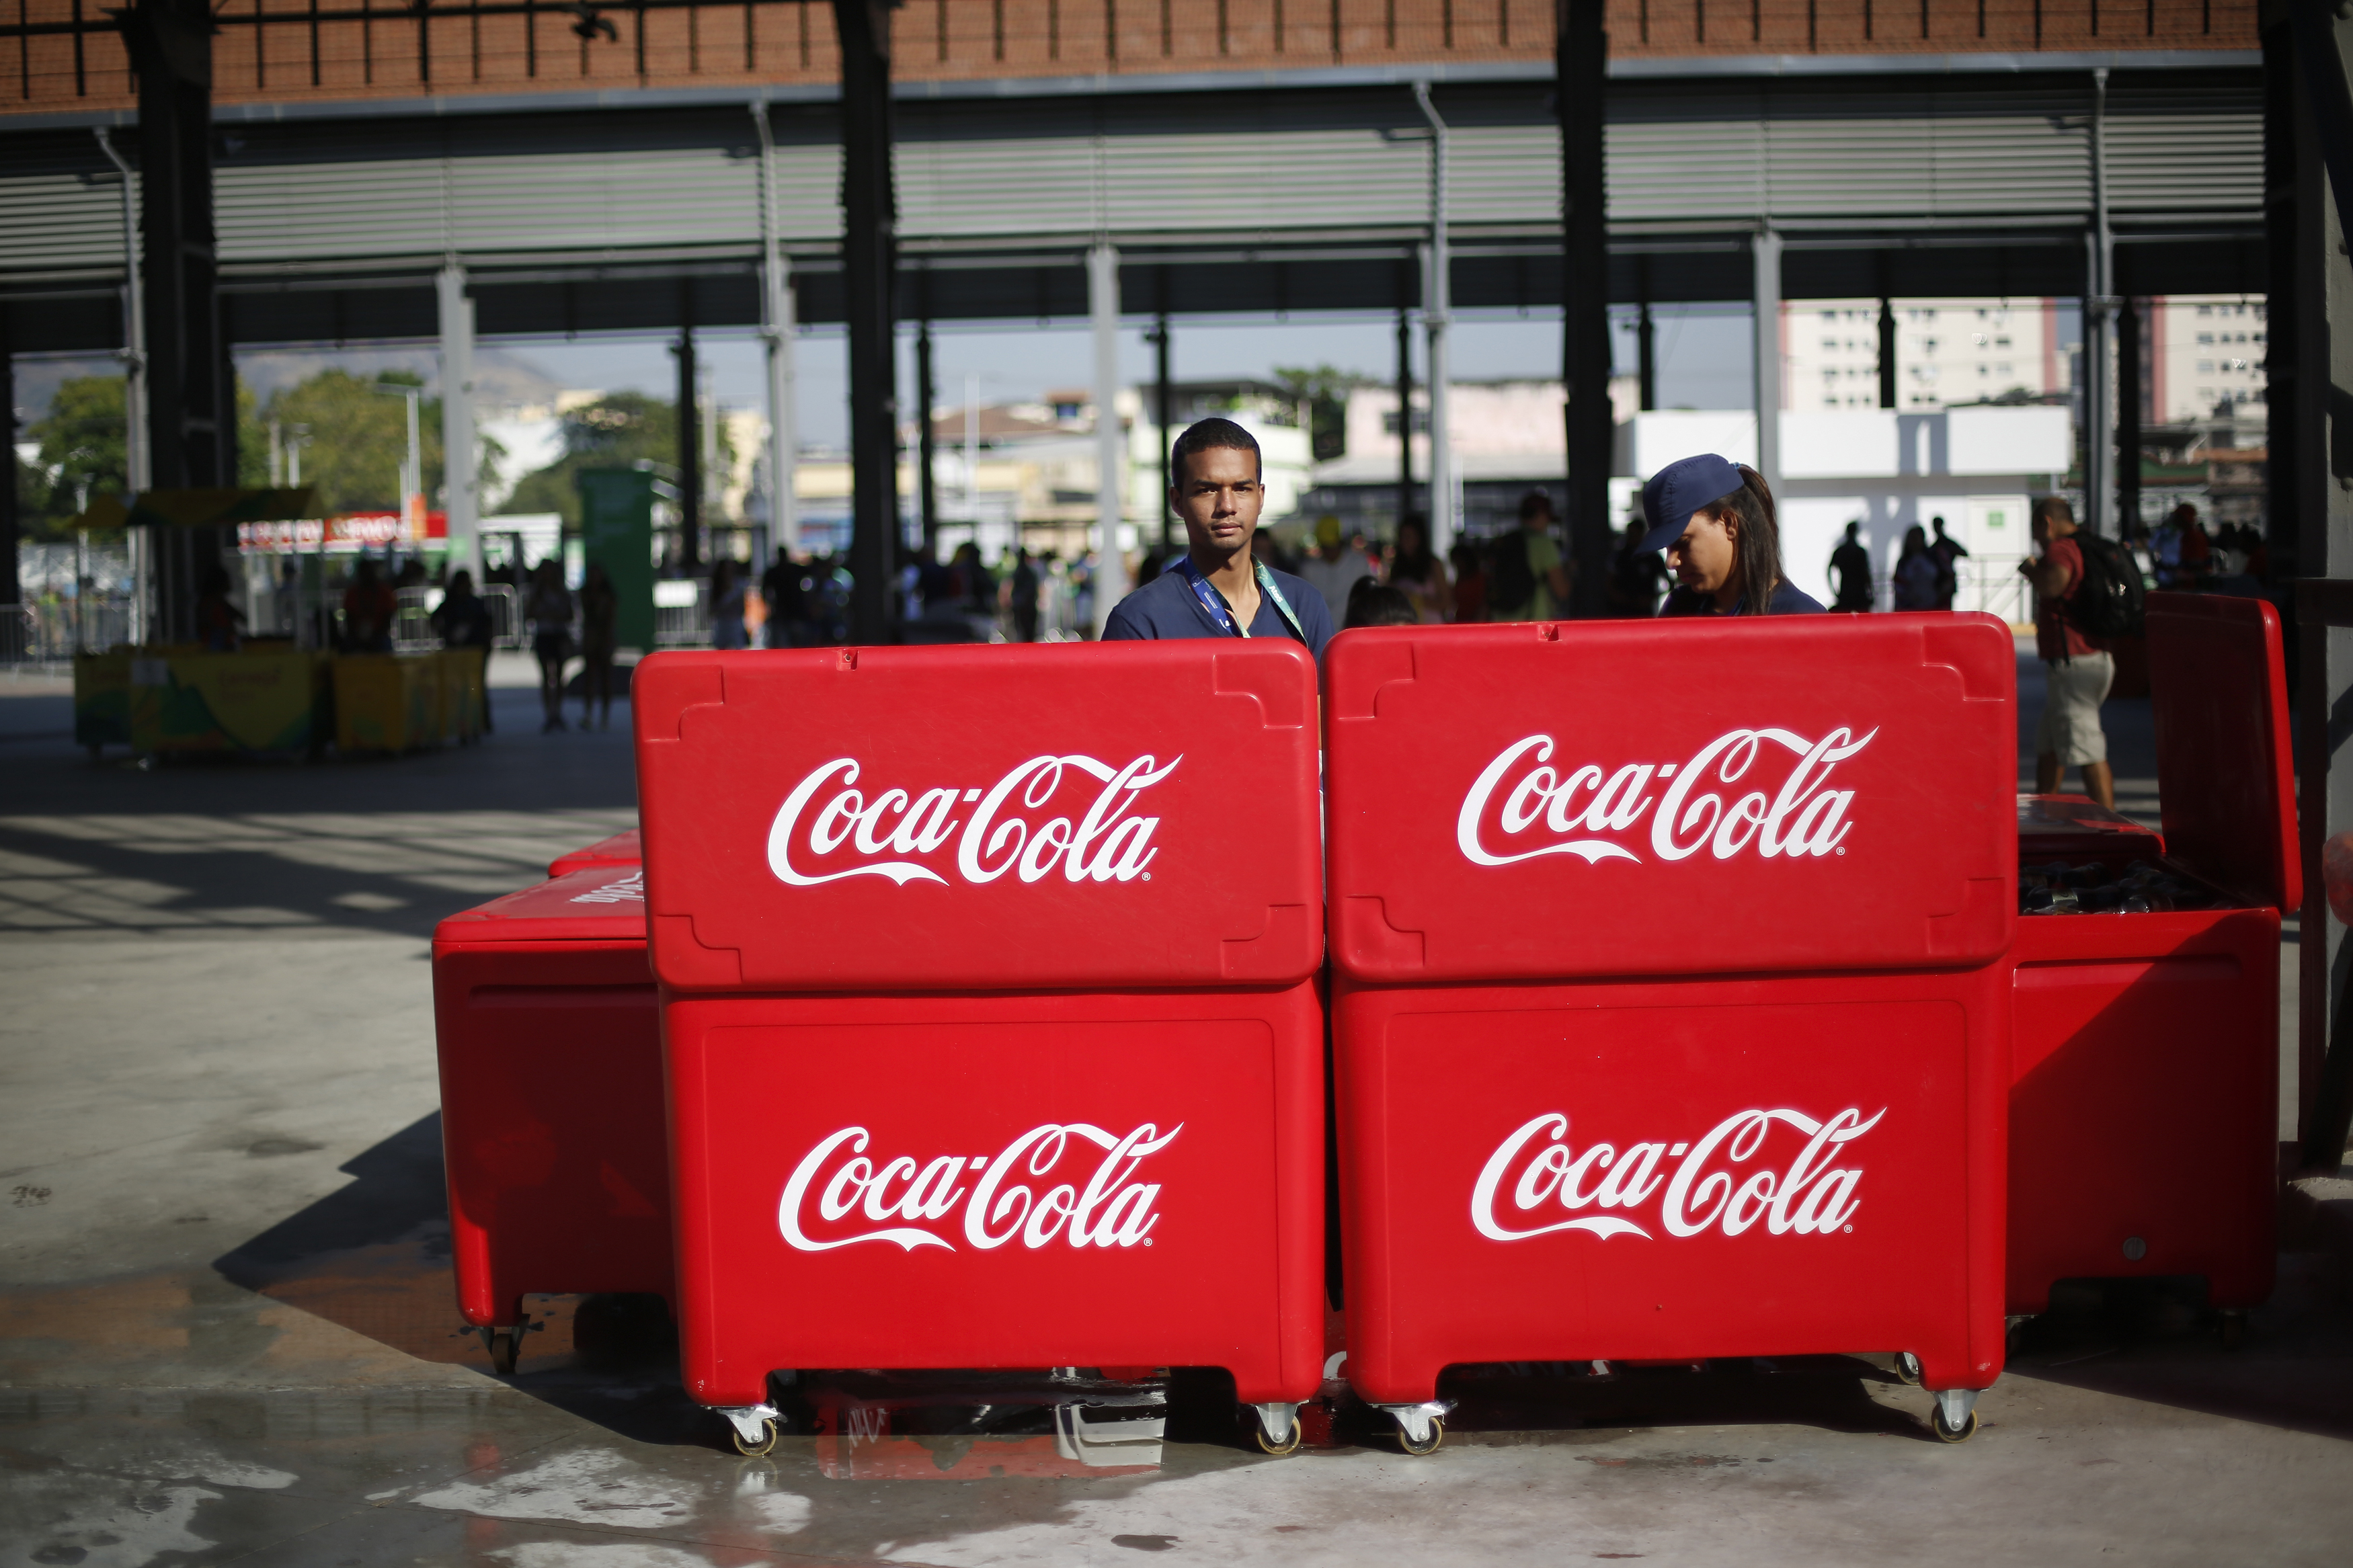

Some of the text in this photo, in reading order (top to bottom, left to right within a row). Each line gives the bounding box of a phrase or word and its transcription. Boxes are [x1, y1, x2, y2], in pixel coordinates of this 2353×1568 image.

[1269, 585, 1283, 603] Atos
[767, 753, 1184, 886] Coca-Cola
[1458, 725, 1880, 866] Coca-Cola
[779, 1121, 1185, 1252] Coca-Cola
[1471, 1106, 1888, 1241] Coca-Cola
